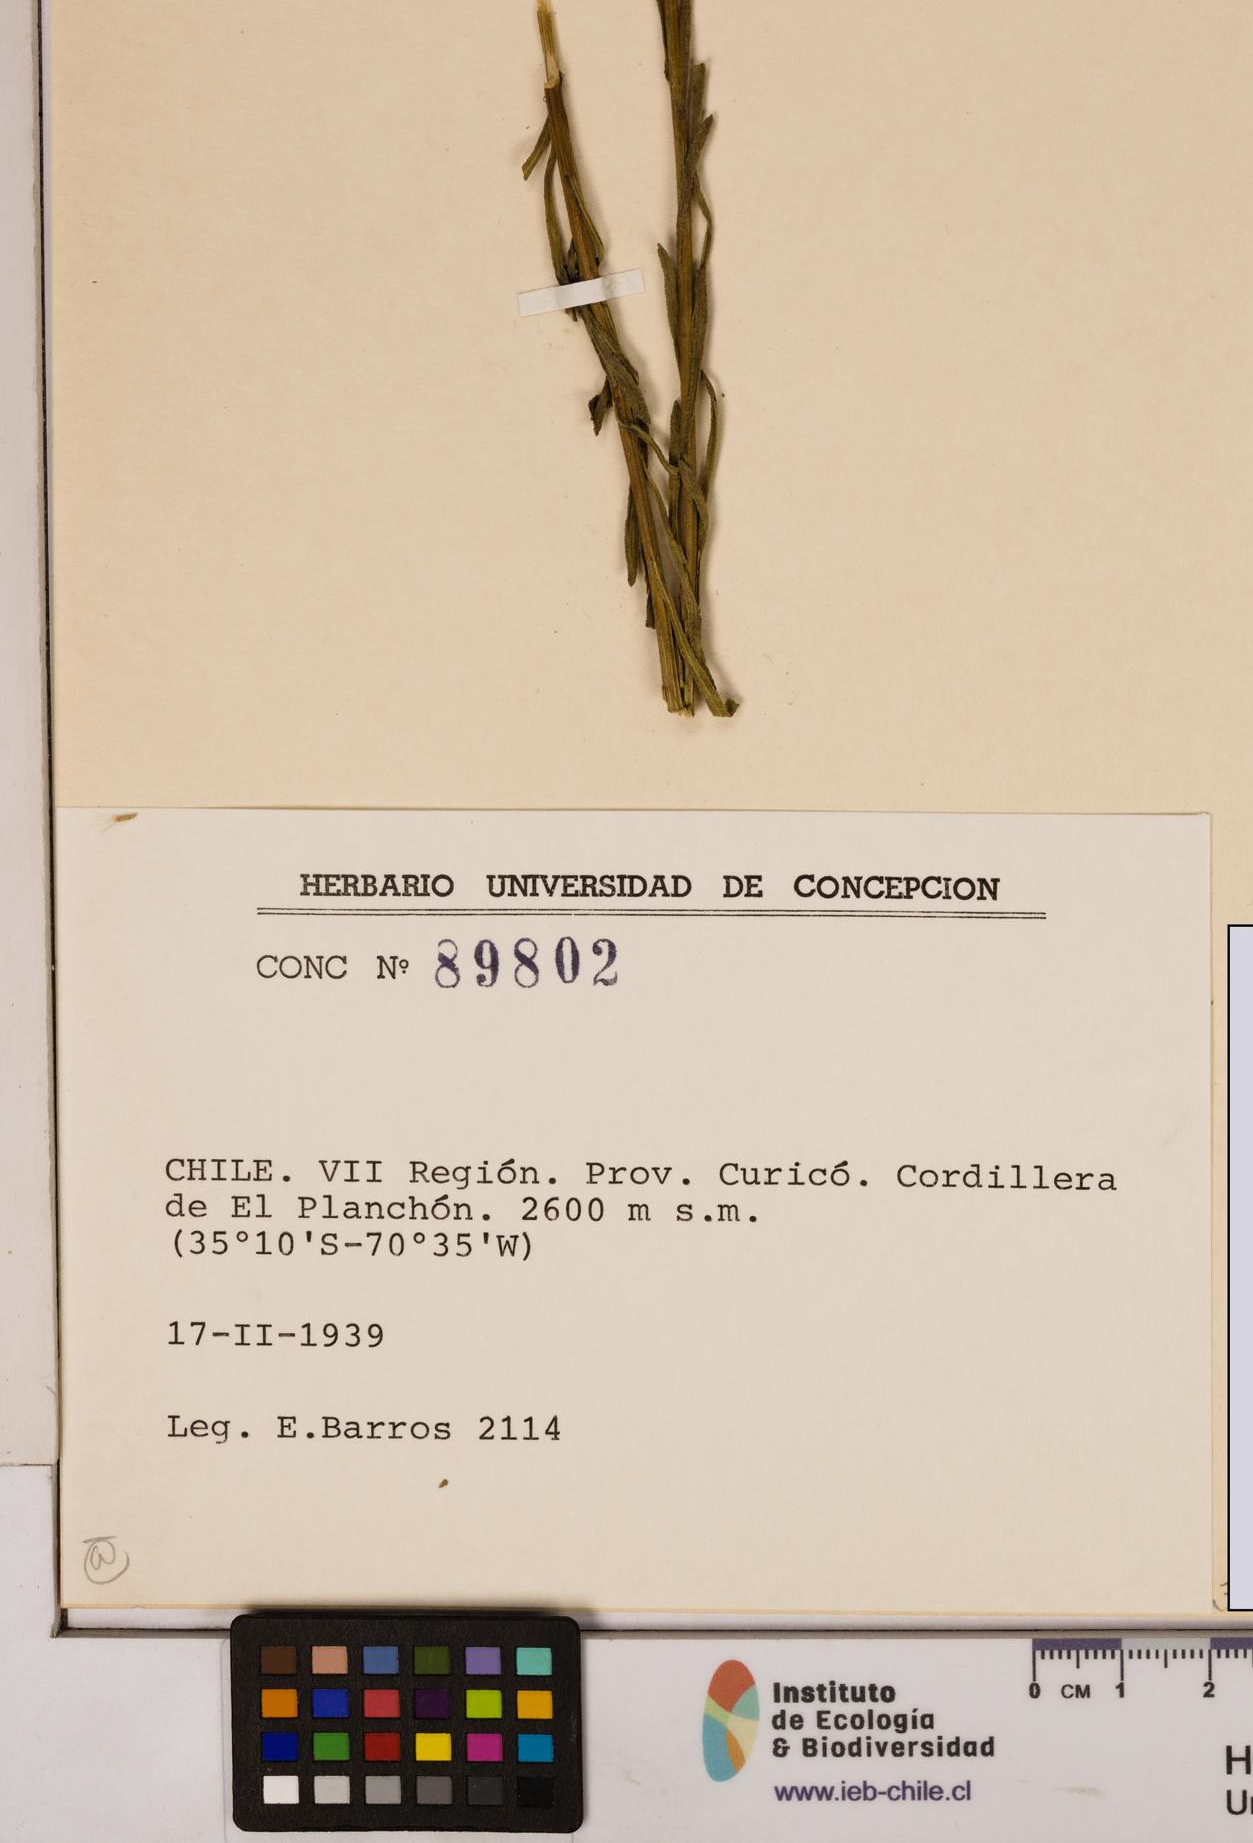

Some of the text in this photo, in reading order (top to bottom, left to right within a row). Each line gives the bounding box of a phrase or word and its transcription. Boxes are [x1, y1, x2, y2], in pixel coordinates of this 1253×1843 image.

[300, 874, 1000, 900] HERBARIO UNIVERSIDAD DE CONCEPCION
[257, 955, 347, 979] CONC
[434, 936, 619, 989] 89802
[165, 1158, 1118, 1191] CHILE. VII Región. Prov. Curicó. Cordillera
[165, 1194, 758, 1223] de El Planchón. 2600 m s.m.
[167, 1321, 384, 1349] 17-II-1939
[167, 1415, 561, 1445] Leg. E.Barros 2114
[772, 1680, 897, 1704] Instituto
[1029, 1683, 1041, 1699] 0
[1061, 1684, 1091, 1699] CM
[1115, 1682, 1126, 1698] 1
[1203, 1682, 1215, 1698] 2
[771, 1708, 935, 1735] de Ecología
[772, 1736, 995, 1758] & Biodiversidad
[773, 1780, 972, 1802] www.ieb-chile.cl
